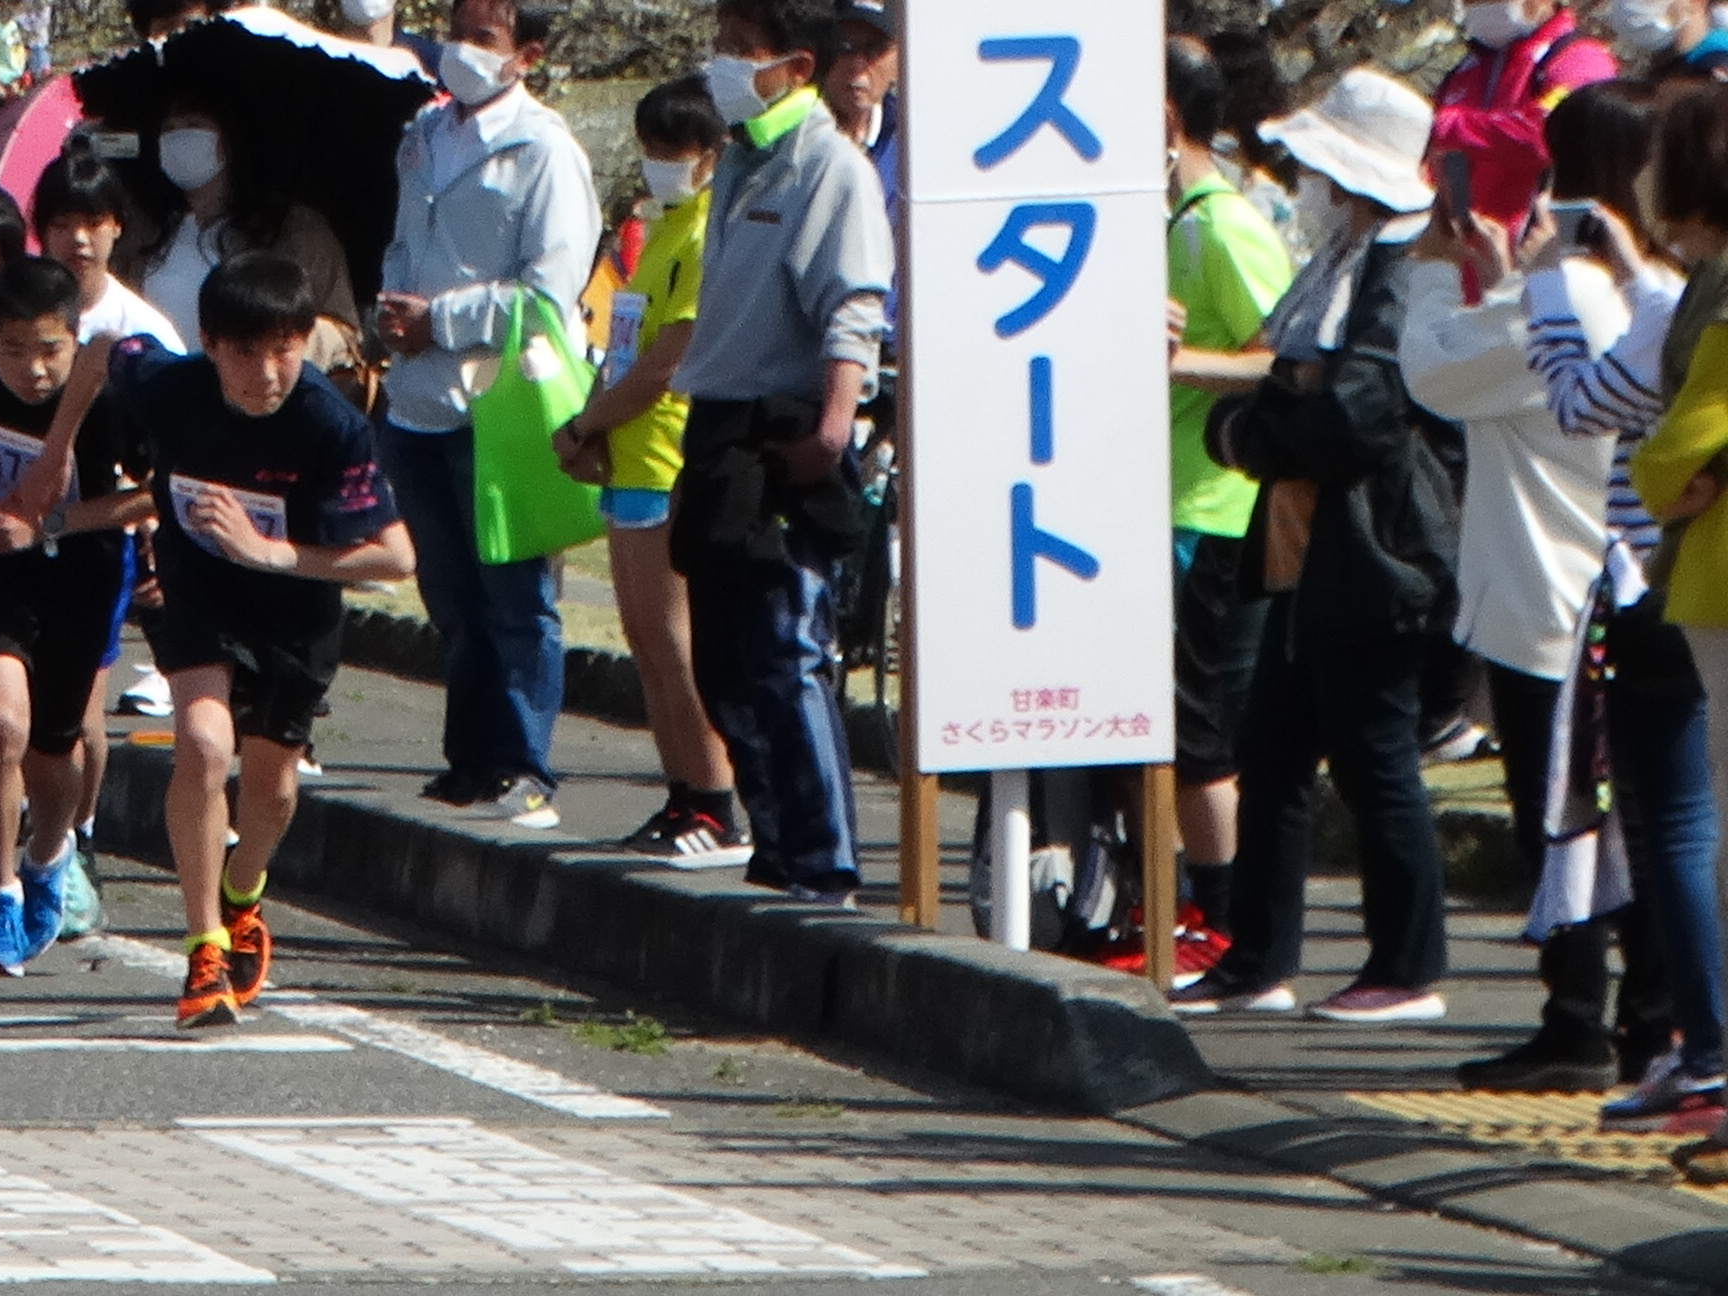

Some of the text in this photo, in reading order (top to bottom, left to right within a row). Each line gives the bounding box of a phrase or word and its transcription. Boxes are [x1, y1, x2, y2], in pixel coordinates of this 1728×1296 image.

[974, 35, 1103, 630] スタート
[941, 713, 1151, 744] さくらマラソン大会
